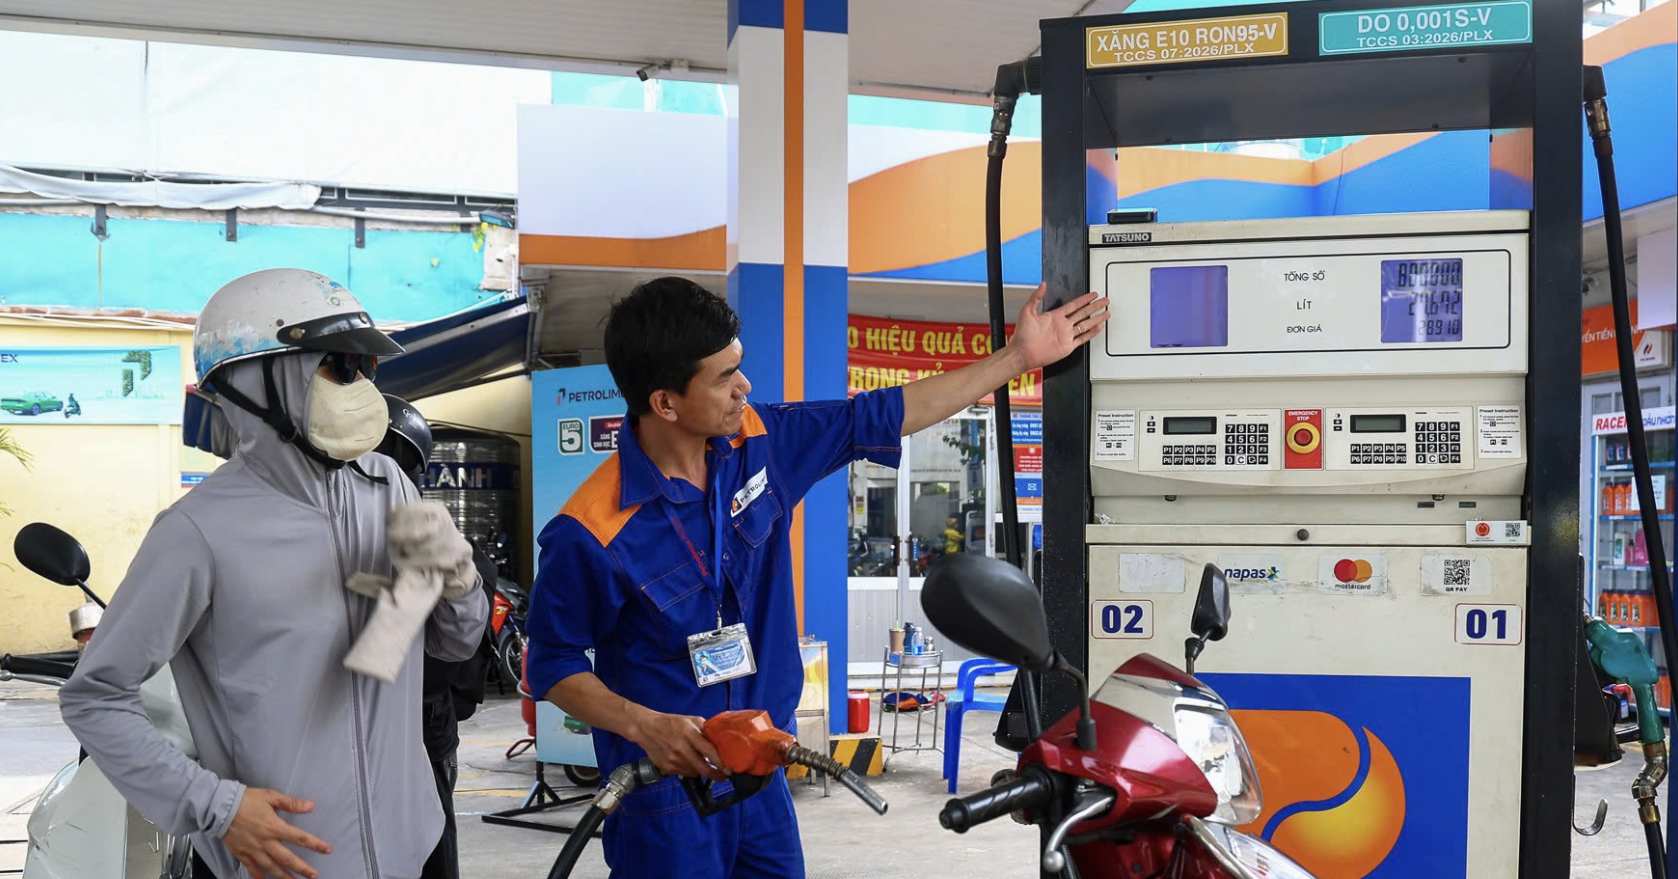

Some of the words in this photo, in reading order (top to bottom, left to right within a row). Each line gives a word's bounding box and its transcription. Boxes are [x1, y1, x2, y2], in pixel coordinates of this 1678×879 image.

[1358, 15, 1391, 33] DO
[1397, 8, 1492, 34] 0,001S-V
[1097, 31, 1150, 52] XĂNG
[1156, 30, 1190, 47] E10
[1195, 23, 1277, 44] RON95-V
[1357, 36, 1398, 48] TCCS
[1403, 30, 1494, 46] 03:2026/PLX
[1114, 50, 1156, 63] TCCS
[1161, 43, 1255, 59] 07:2026/PLX
[1104, 233, 1150, 242] TATSUNO
[1312, 270, 1326, 281] SỐ
[1296, 298, 1312, 310] LÍT
[1307, 324, 1322, 333] GIÁ
[866, 325, 916, 356] HIỆU
[922, 326, 966, 355] QUẢ
[848, 366, 911, 391] RONG
[562, 422, 579, 430] EURO
[561, 430, 580, 451] 5
[1224, 569, 1266, 581] napas
[1101, 604, 1144, 634] 02
[1466, 609, 1506, 639] 01
